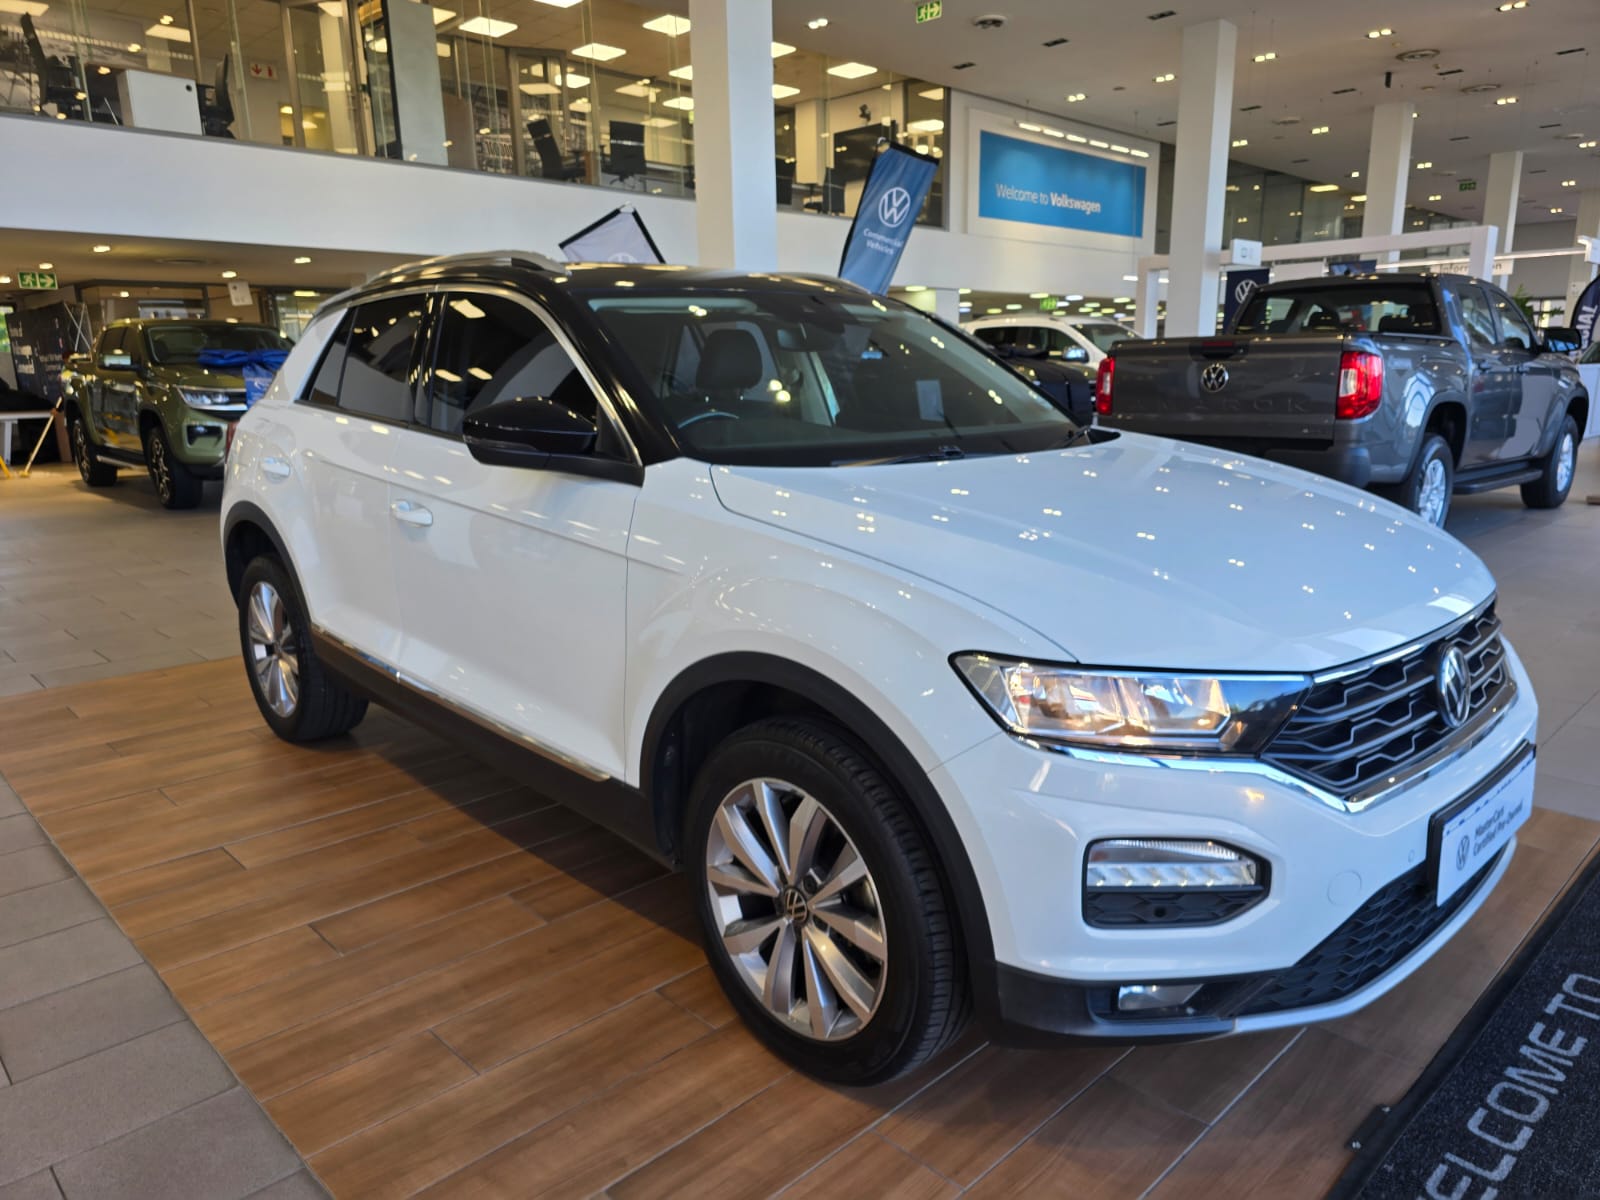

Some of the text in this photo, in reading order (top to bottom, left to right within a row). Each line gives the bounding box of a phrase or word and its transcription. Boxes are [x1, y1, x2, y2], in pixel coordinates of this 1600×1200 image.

[995, 183, 1101, 215] Welcome to Volkswagen
[1417, 1022, 1588, 1200] ELCOME
